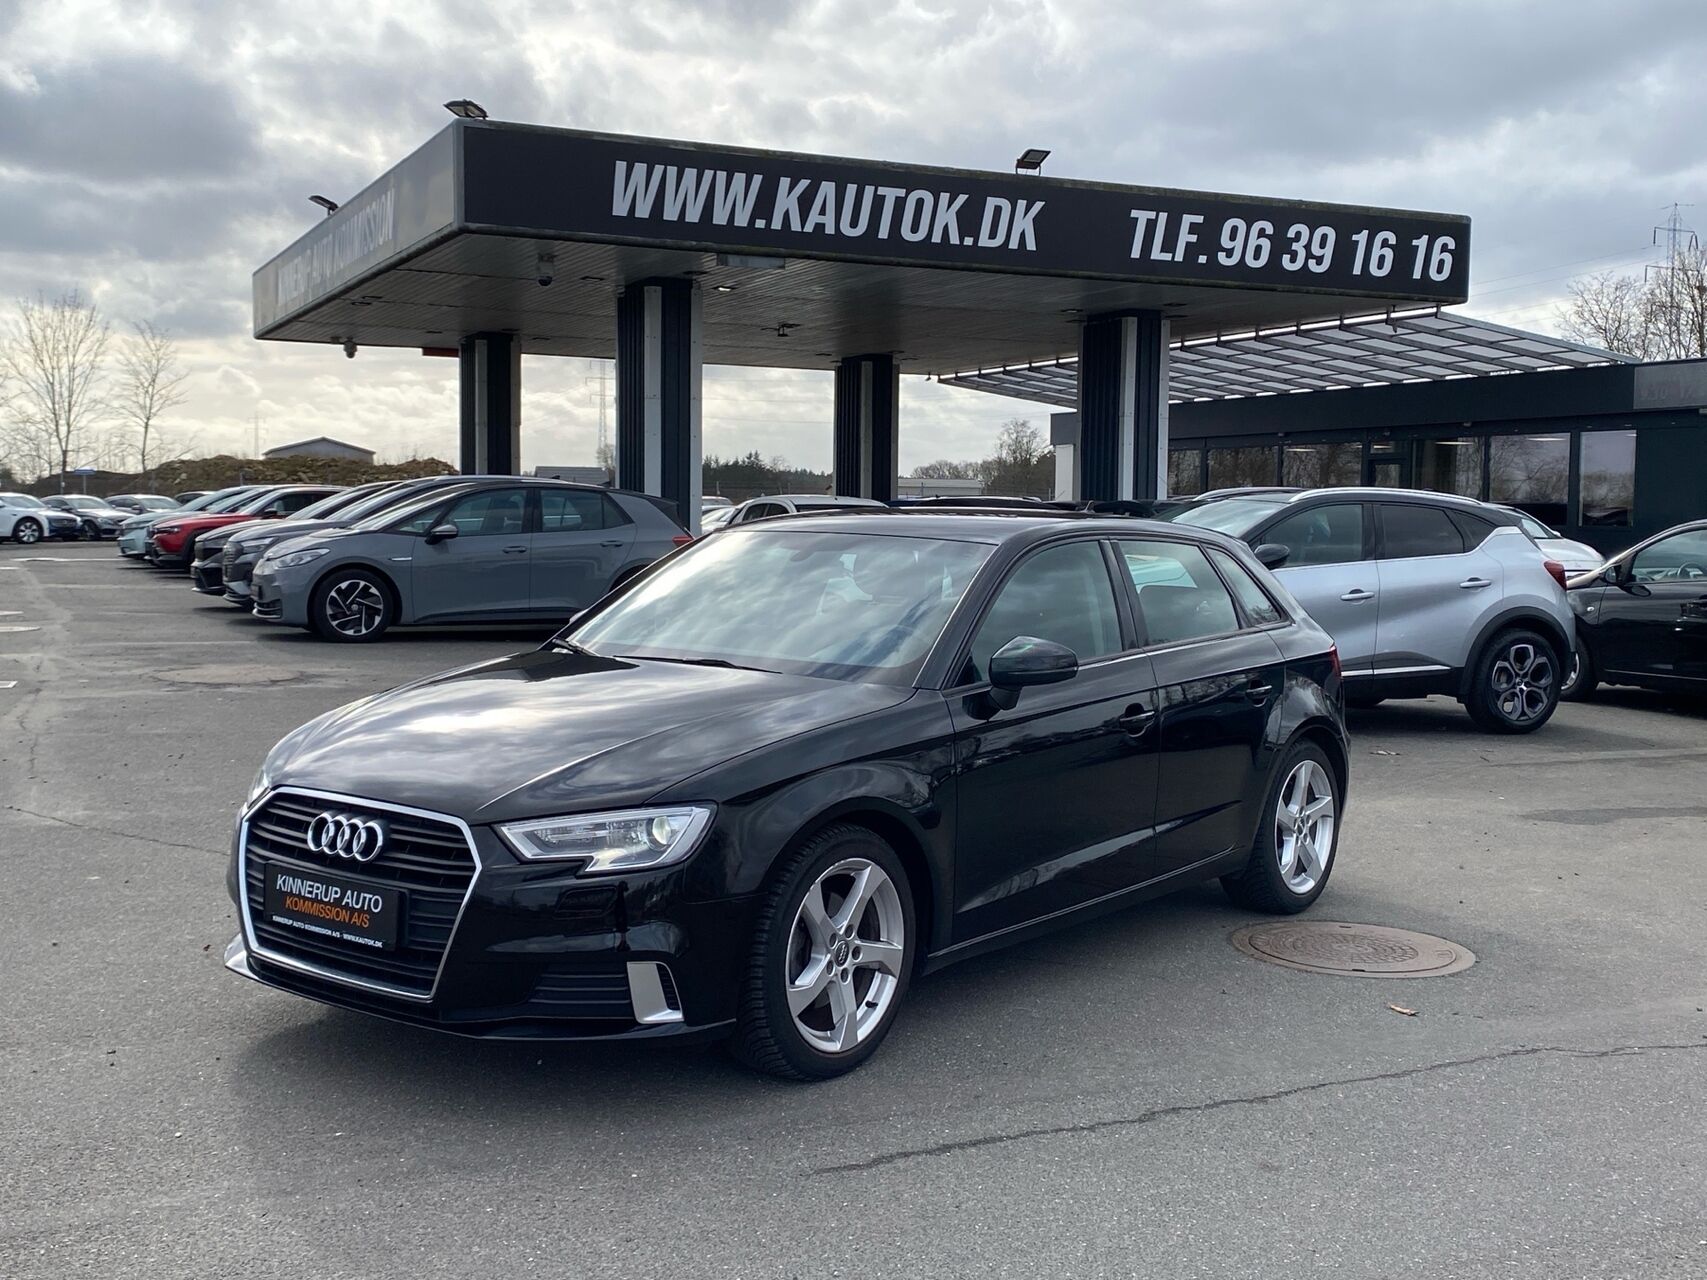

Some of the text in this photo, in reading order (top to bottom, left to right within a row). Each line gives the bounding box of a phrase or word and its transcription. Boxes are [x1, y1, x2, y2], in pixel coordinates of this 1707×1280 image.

[612, 160, 1045, 251] WWW.KAUTOK.DK
[1130, 209, 1456, 281] TLF. 96 39 16 16
[276, 874, 382, 913] KINNERUP AUTO
[286, 896, 370, 928] KOMMISSION A/S
